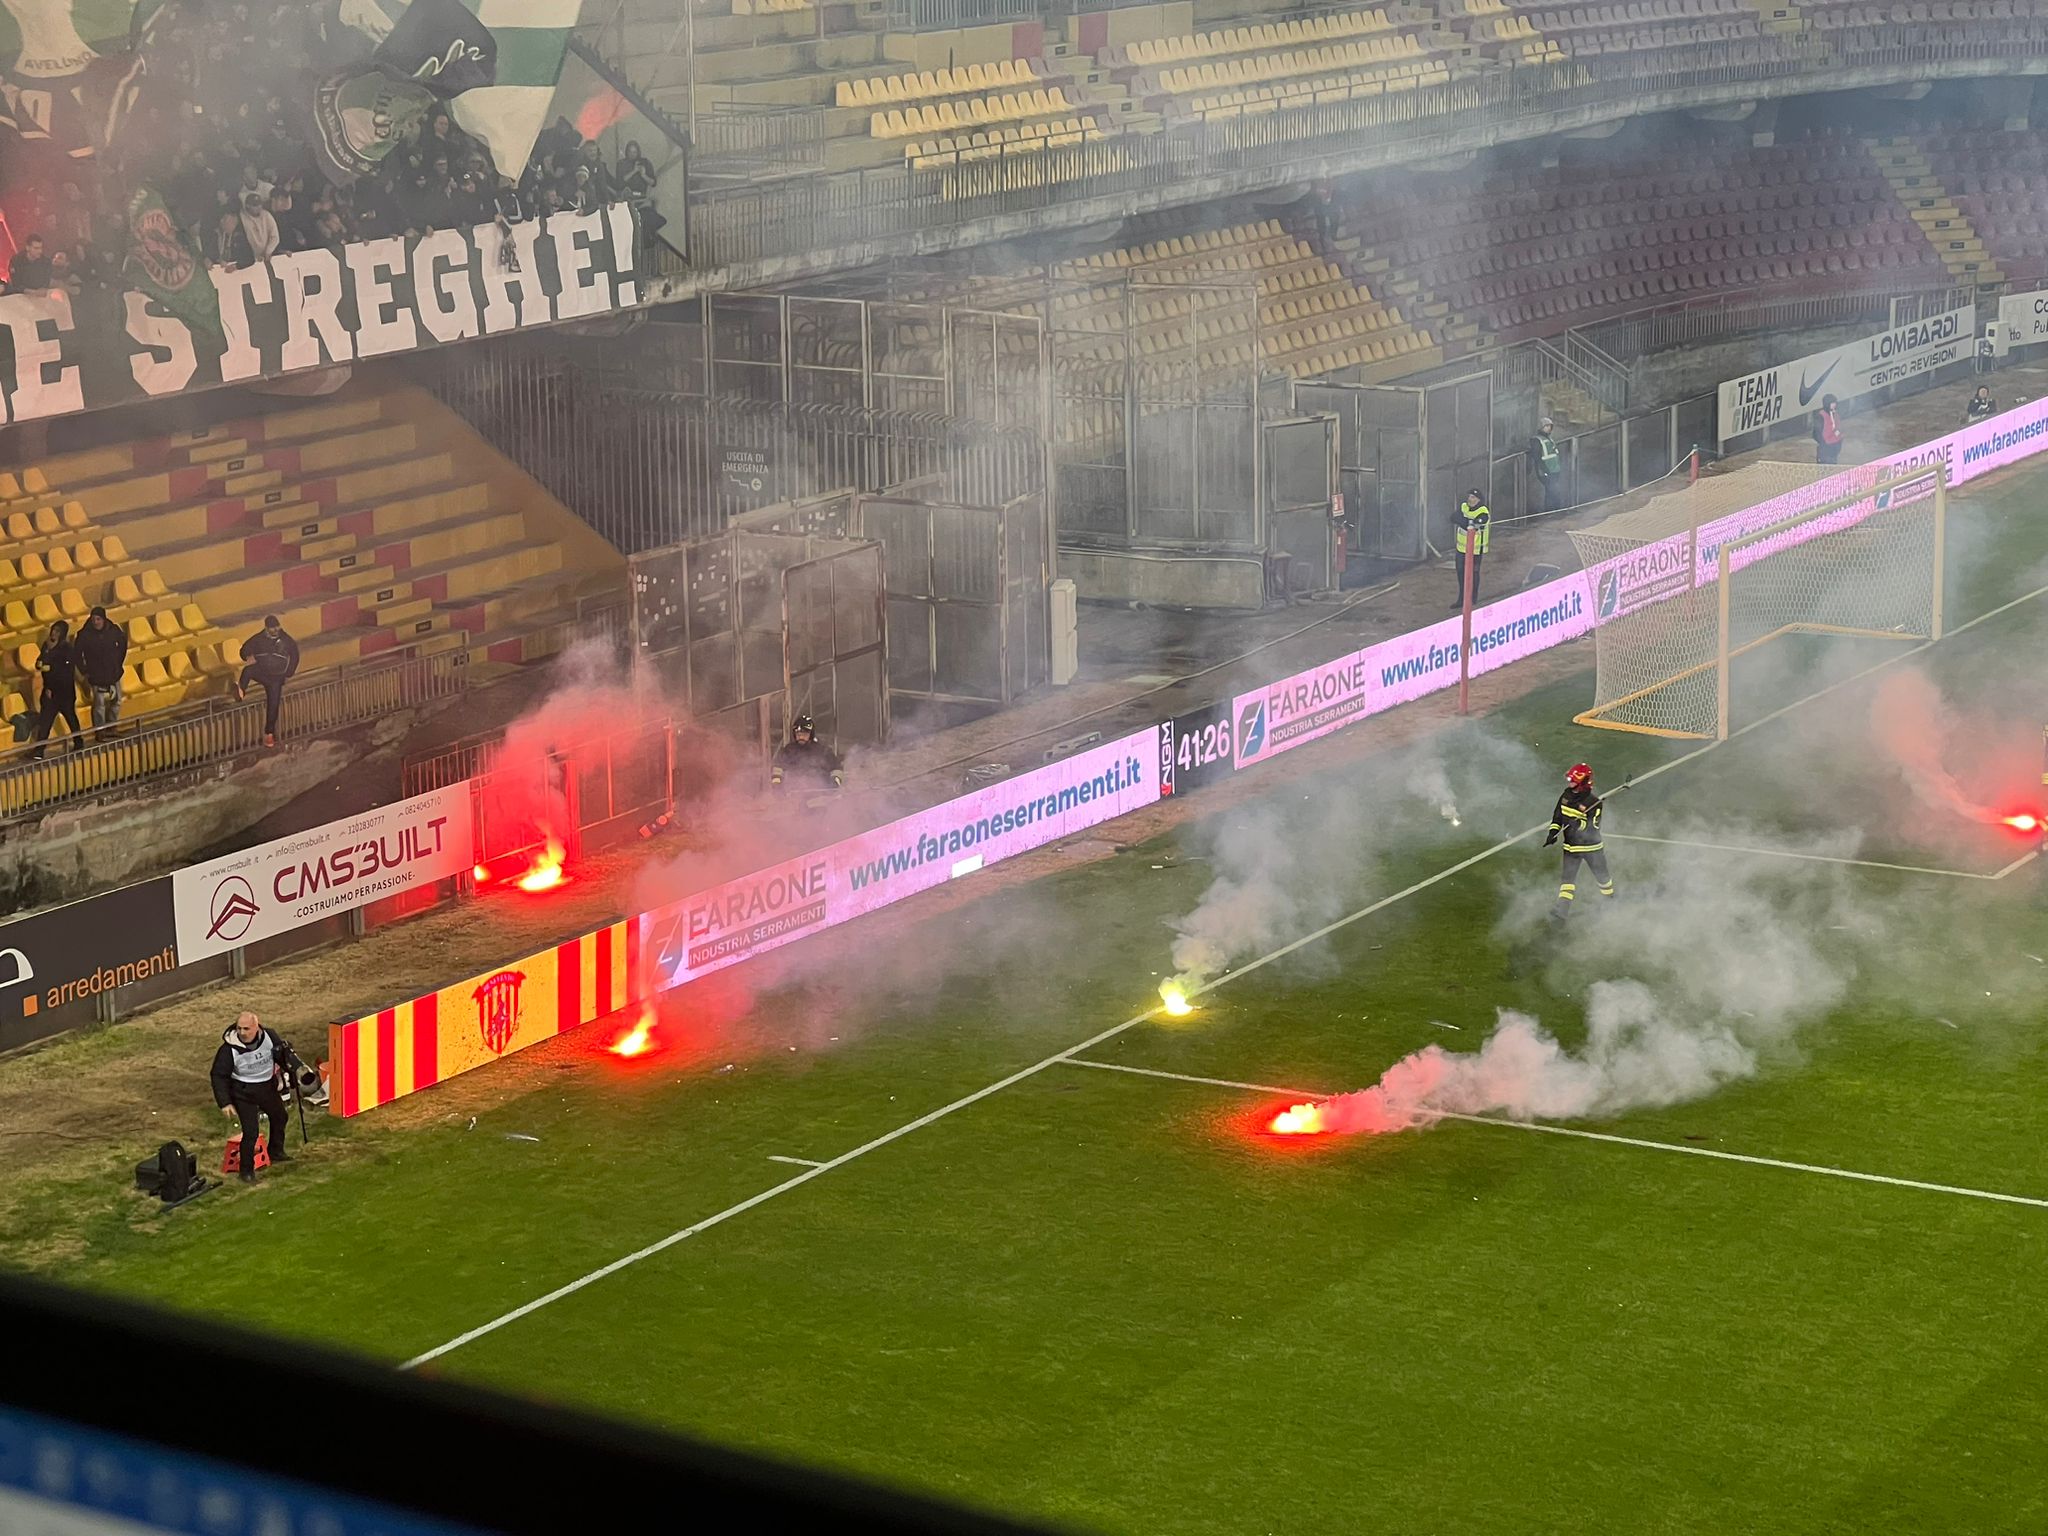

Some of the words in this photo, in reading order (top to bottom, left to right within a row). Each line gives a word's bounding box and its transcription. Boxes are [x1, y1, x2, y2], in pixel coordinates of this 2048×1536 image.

[122, 200, 639, 396] STREGHE!
[1871, 313, 1958, 361] LOMBARDI
[1738, 371, 1777, 406] TEAM
[1870, 363, 1907, 386] CENTRO
[1910, 346, 1957, 373] REVISIONI
[1740, 395, 1782, 430] WEAR
[722, 462, 769, 474] EMERGENZA
[726, 451, 753, 462] USCITA
[755, 453, 765, 463] DI
[1619, 540, 1690, 588] FARAONE
[1269, 660, 1366, 723] FARAONE
[1381, 590, 1583, 688] www.faraneserramenti.it
[1161, 720, 1172, 784] NGM
[1177, 719, 1230, 771] 41:26
[688, 862, 827, 940] FARAONE
[849, 756, 1141, 891] www.faraoneserramenti.it
[354, 886, 371, 899] PER
[689, 933, 751, 966] INDUSTRIA
[752, 904, 825, 942] SERRAMENTI
[47, 944, 176, 1009] arredamenti
